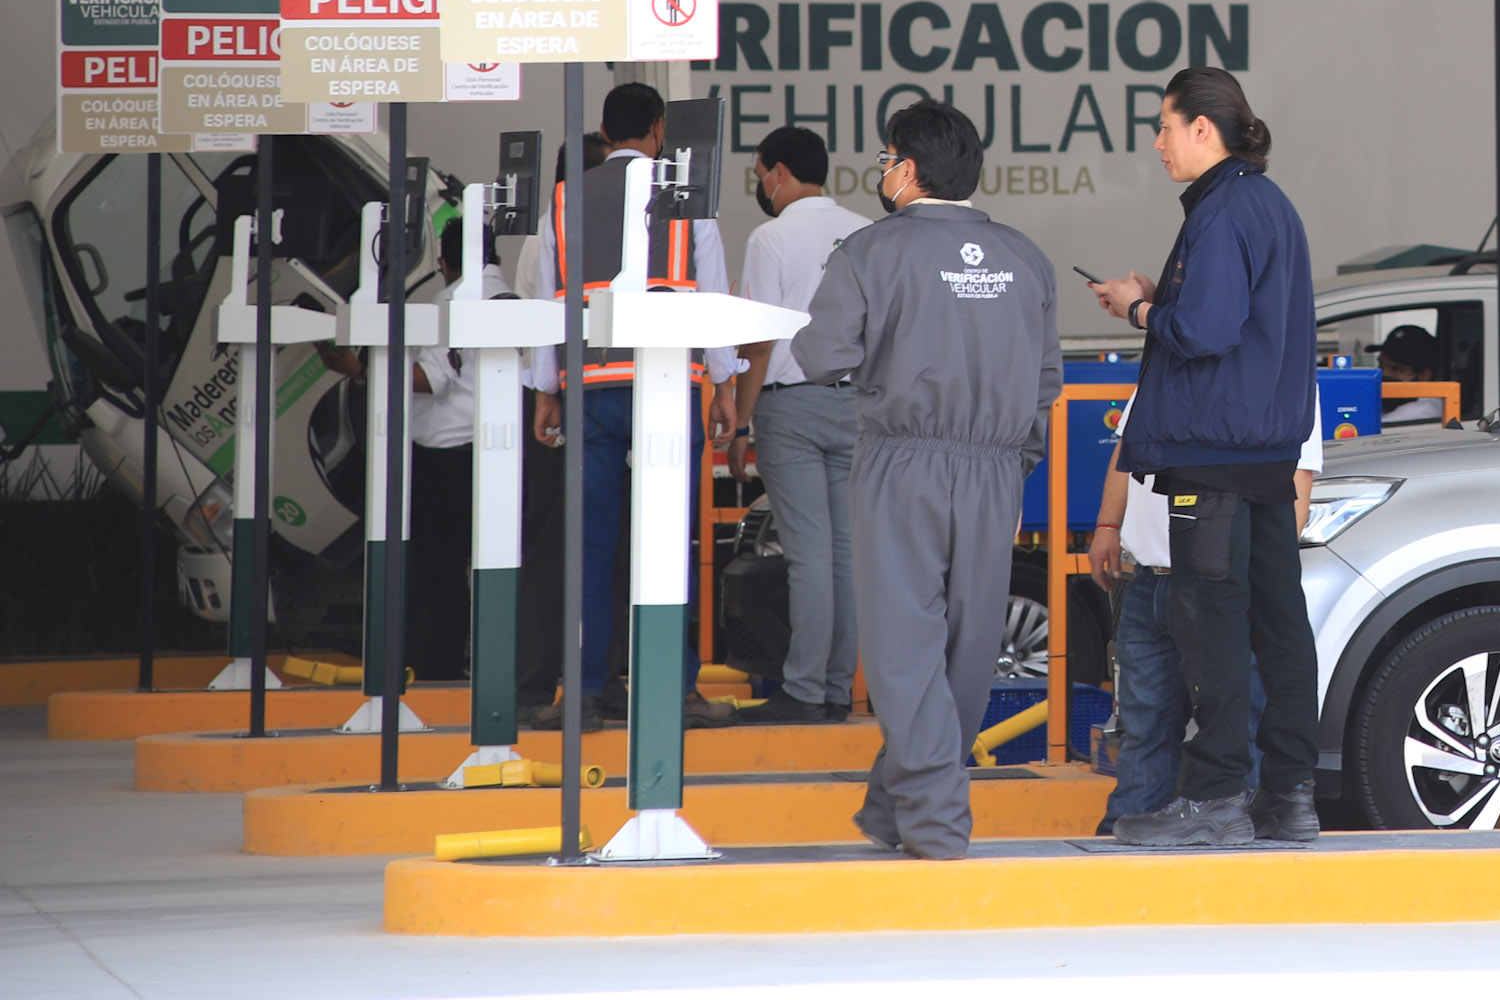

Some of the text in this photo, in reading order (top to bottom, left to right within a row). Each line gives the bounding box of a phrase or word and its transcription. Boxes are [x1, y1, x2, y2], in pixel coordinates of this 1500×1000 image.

[80, 5, 159, 18] VEHICULA
[475, 7, 599, 29] EN ÁREA DE
[305, 33, 421, 51] COLÓQUESE
[496, 37, 579, 54] ESPERA
[85, 56, 156, 83] PELI
[310, 55, 419, 73] EN ÁREA DE
[329, 80, 400, 95] ESPERA
[81, 97, 159, 112] COLÓQUE
[188, 91, 284, 107] EN ÁREA DE
[85, 118, 107, 130] EN
[108, 114, 149, 130] ÁREA
[204, 114, 267, 127] ESPERA
[100, 135, 157, 147] ESPERA
[979, 166, 1096, 195] UEBLA
[940, 271, 1013, 283] VERIFICACIÓN
[950, 283, 1006, 293] VEHICULAR
[277, 503, 301, 523] 20
